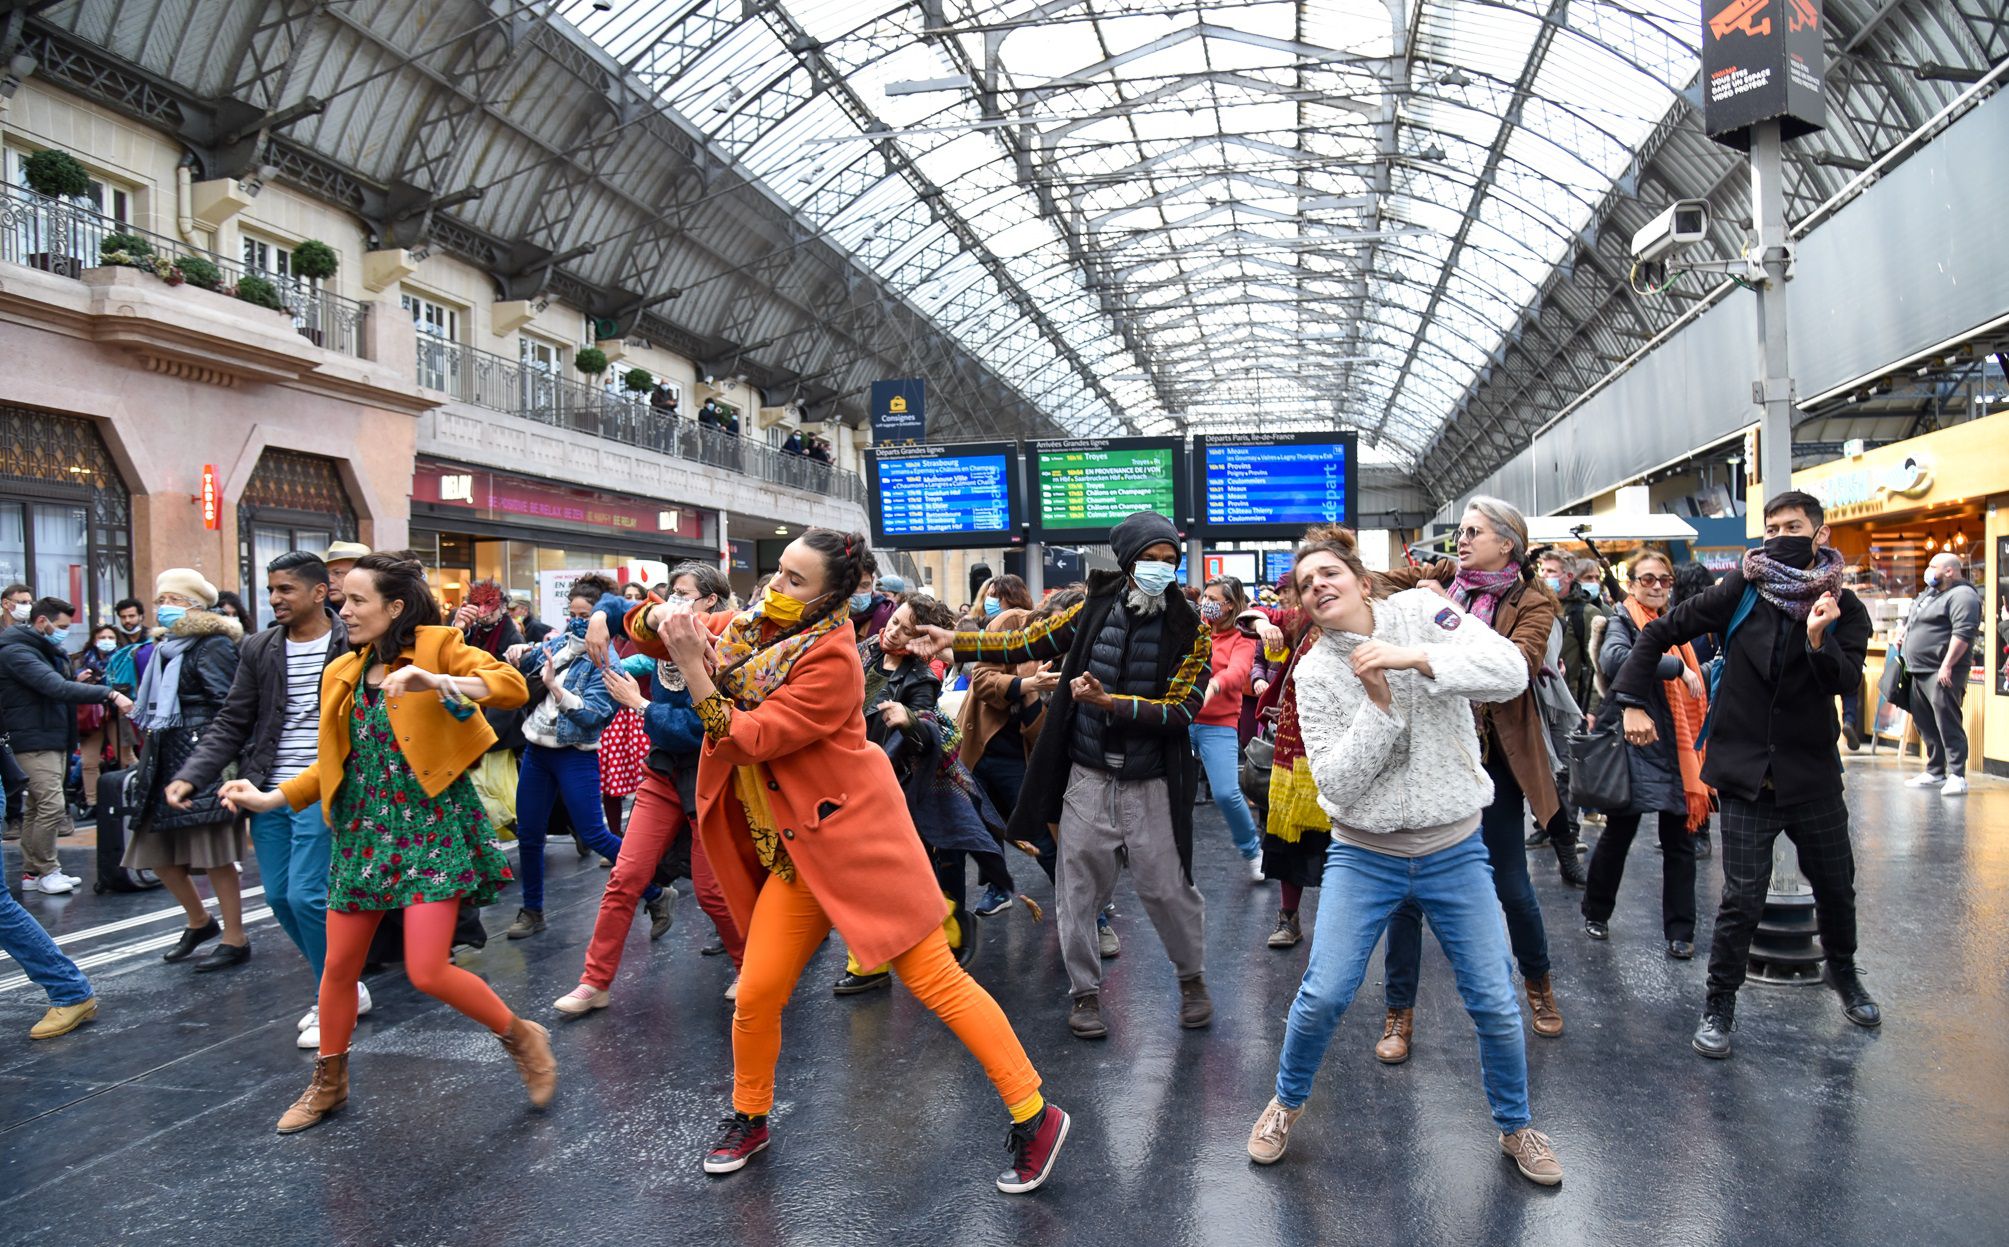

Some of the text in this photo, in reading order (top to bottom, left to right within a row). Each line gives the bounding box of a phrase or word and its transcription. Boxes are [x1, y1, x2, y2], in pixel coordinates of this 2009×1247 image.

[881, 414, 916, 422] Consignes
[1205, 434, 1231, 442] Départs
[1232, 434, 1250, 442] Paris,
[1090, 439, 1109, 448] lignes
[875, 446, 945, 457] Départs Grandes lignes
[1085, 452, 1108, 461] Troyes
[1280, 453, 1296, 461] Lagny
[922, 459, 959, 468] Strasbourg
[1227, 462, 1251, 470] Provins
[441, 474, 473, 504] RELAY
[1322, 463, 1340, 522] départ
[203, 473, 214, 521] TABAC
[1118, 503, 1152, 511] Champagne
[1252, 507, 1273, 515] Thierry
